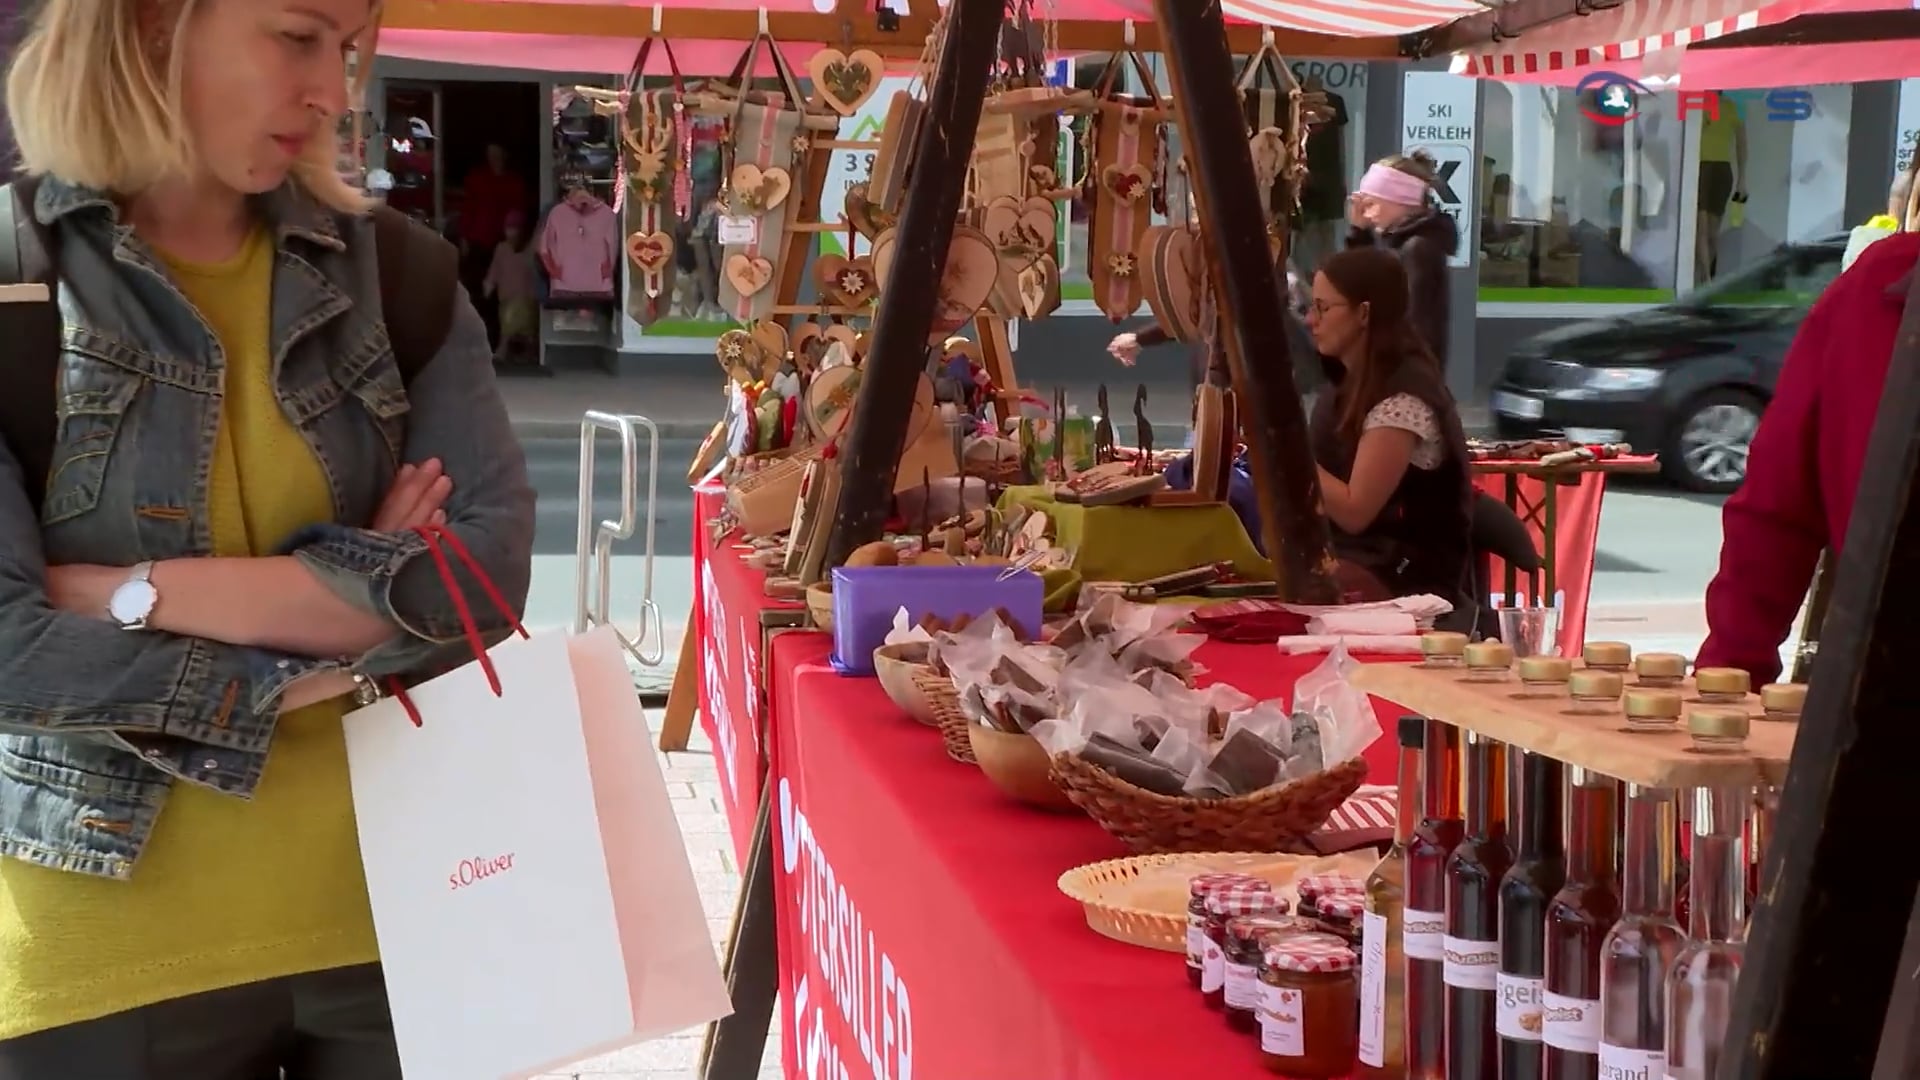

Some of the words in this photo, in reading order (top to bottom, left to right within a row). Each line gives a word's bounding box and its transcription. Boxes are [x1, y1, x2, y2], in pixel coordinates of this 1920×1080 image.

[1427, 103, 1452, 118] SKI
[1407, 125, 1472, 140] VERLEIH
[845, 153, 857, 172] 3
[449, 853, 515, 890] s.Oliver
